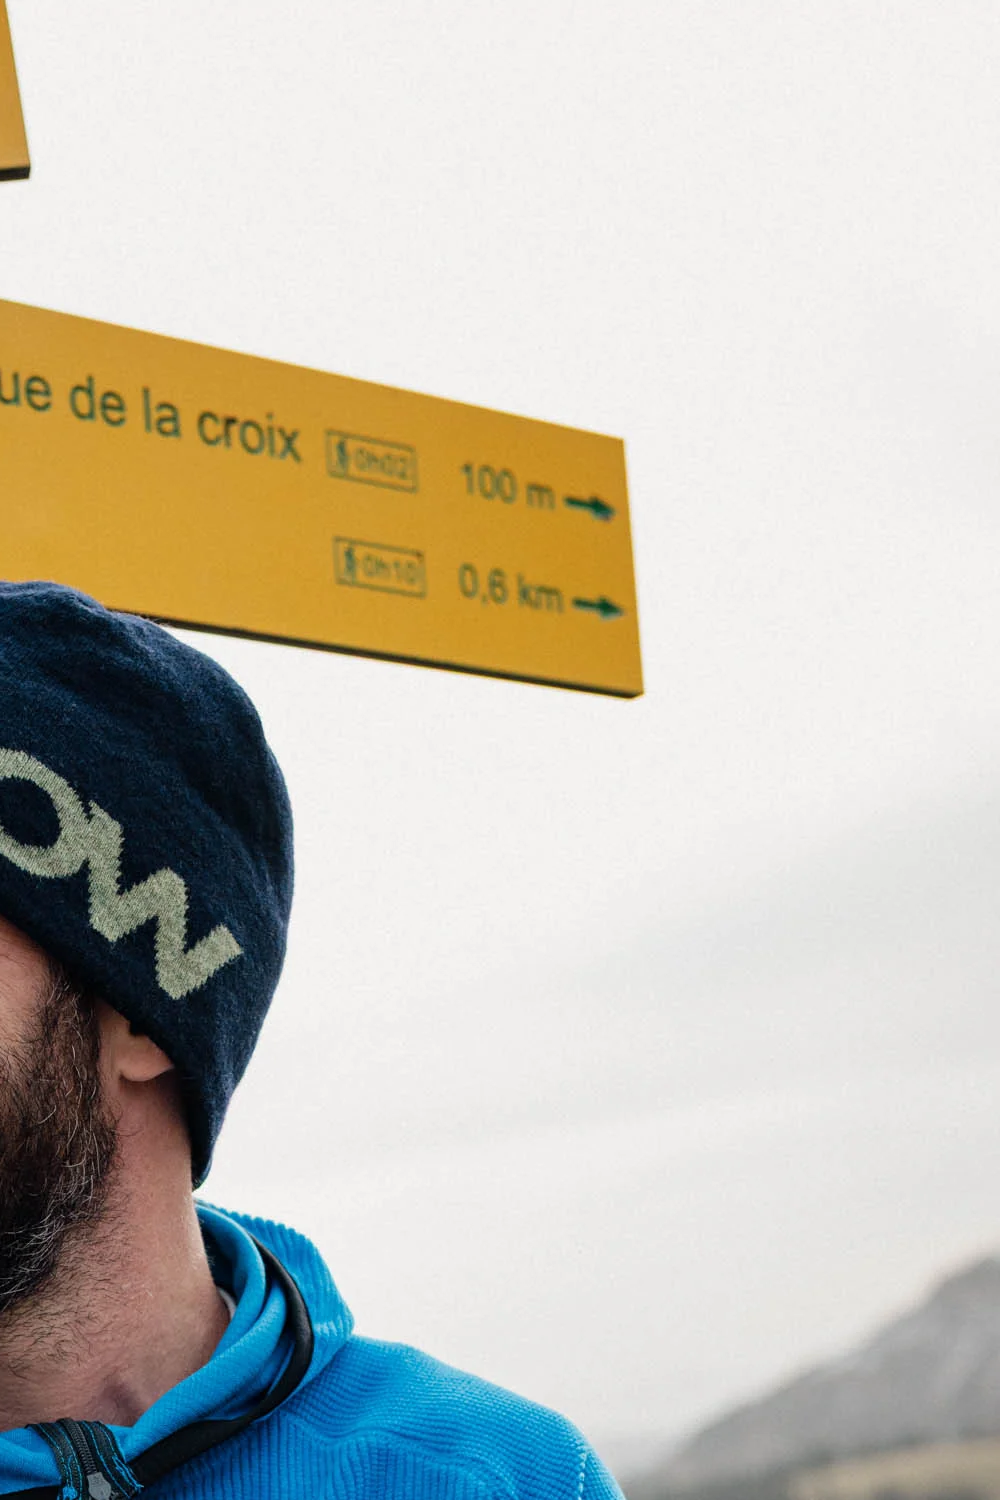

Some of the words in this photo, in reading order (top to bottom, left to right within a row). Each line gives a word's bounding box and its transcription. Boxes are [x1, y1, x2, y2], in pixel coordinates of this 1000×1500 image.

[70, 376, 126, 427] de
[142, 388, 182, 438] la
[198, 408, 303, 463] croix
[459, 463, 518, 503] 100
[526, 482, 556, 509] m
[517, 574, 565, 613] km
